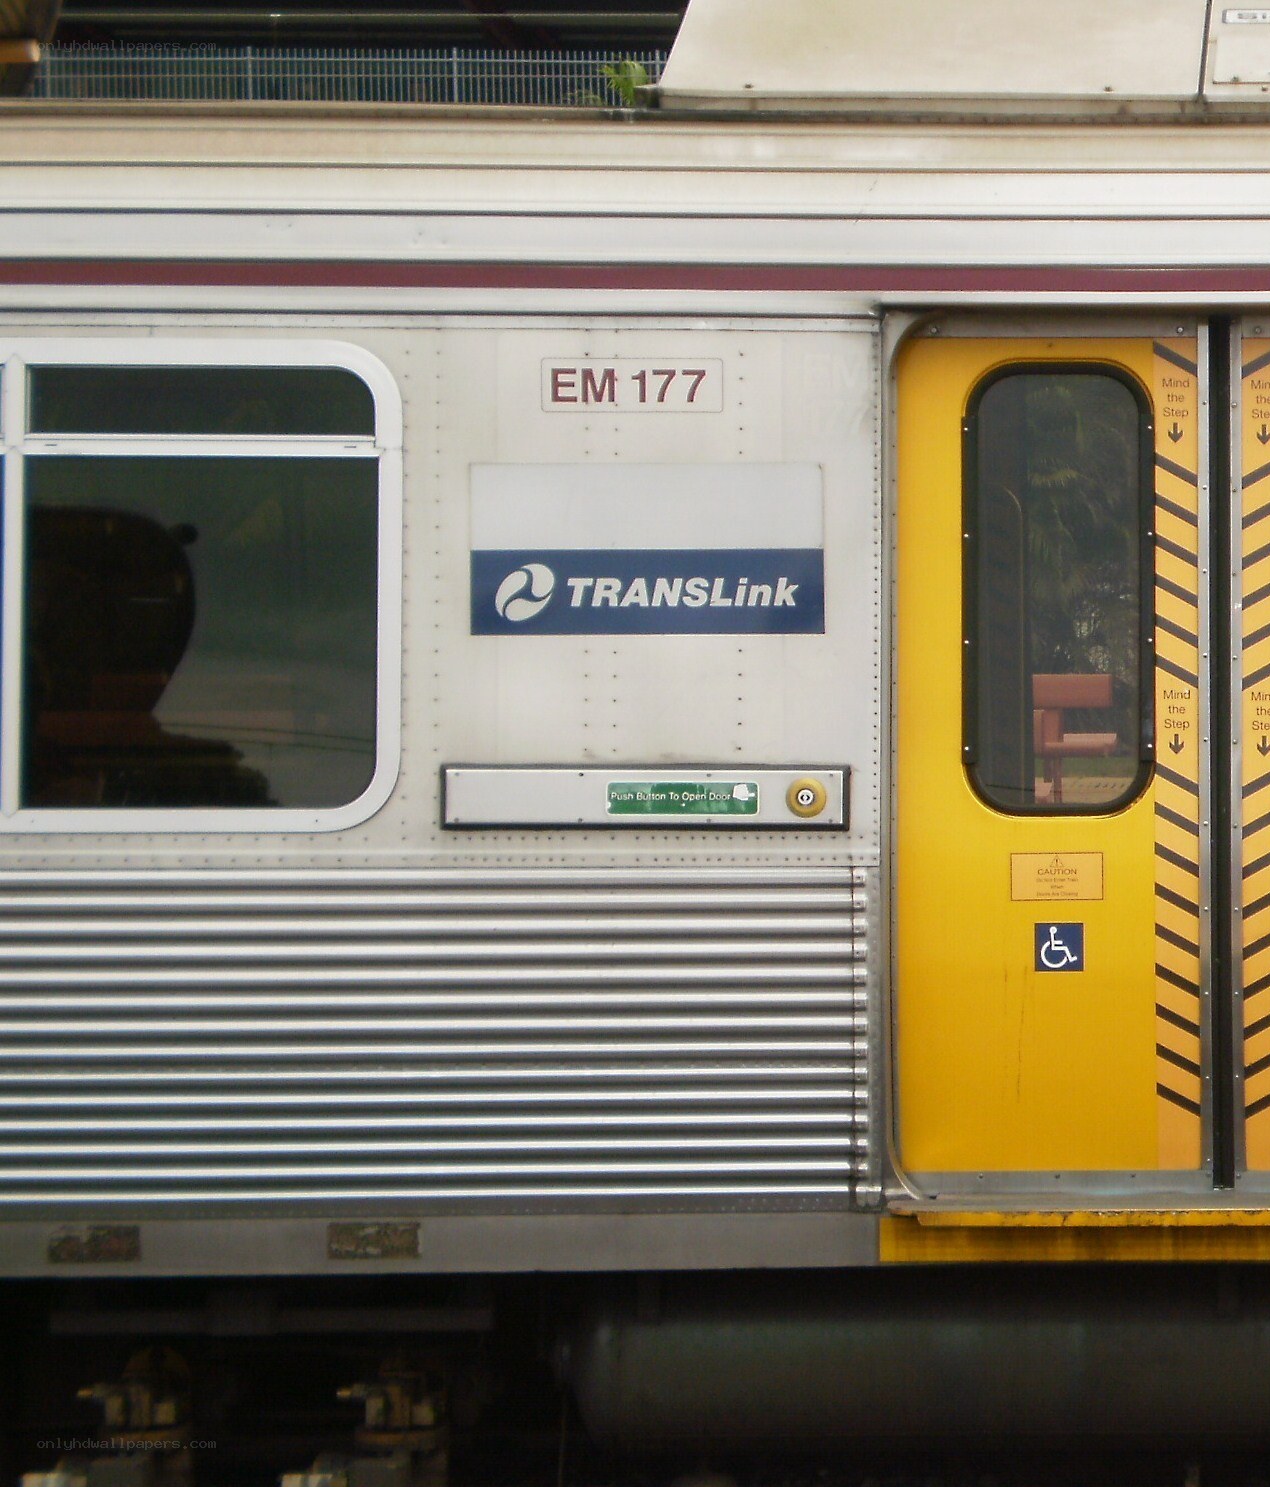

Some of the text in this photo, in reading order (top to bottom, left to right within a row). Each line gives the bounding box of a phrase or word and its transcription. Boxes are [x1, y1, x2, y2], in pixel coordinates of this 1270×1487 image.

[551, 368, 706, 403] EM 177
[1162, 378, 1190, 388] Mind
[1167, 392, 1185, 402] the
[1163, 407, 1189, 418] Step
[567, 577, 799, 607] TRANSLink
[1163, 690, 1191, 700] Mind
[1168, 705, 1186, 714] the
[1164, 719, 1190, 731] Step
[611, 792, 731, 801] Push Button To Open Door
